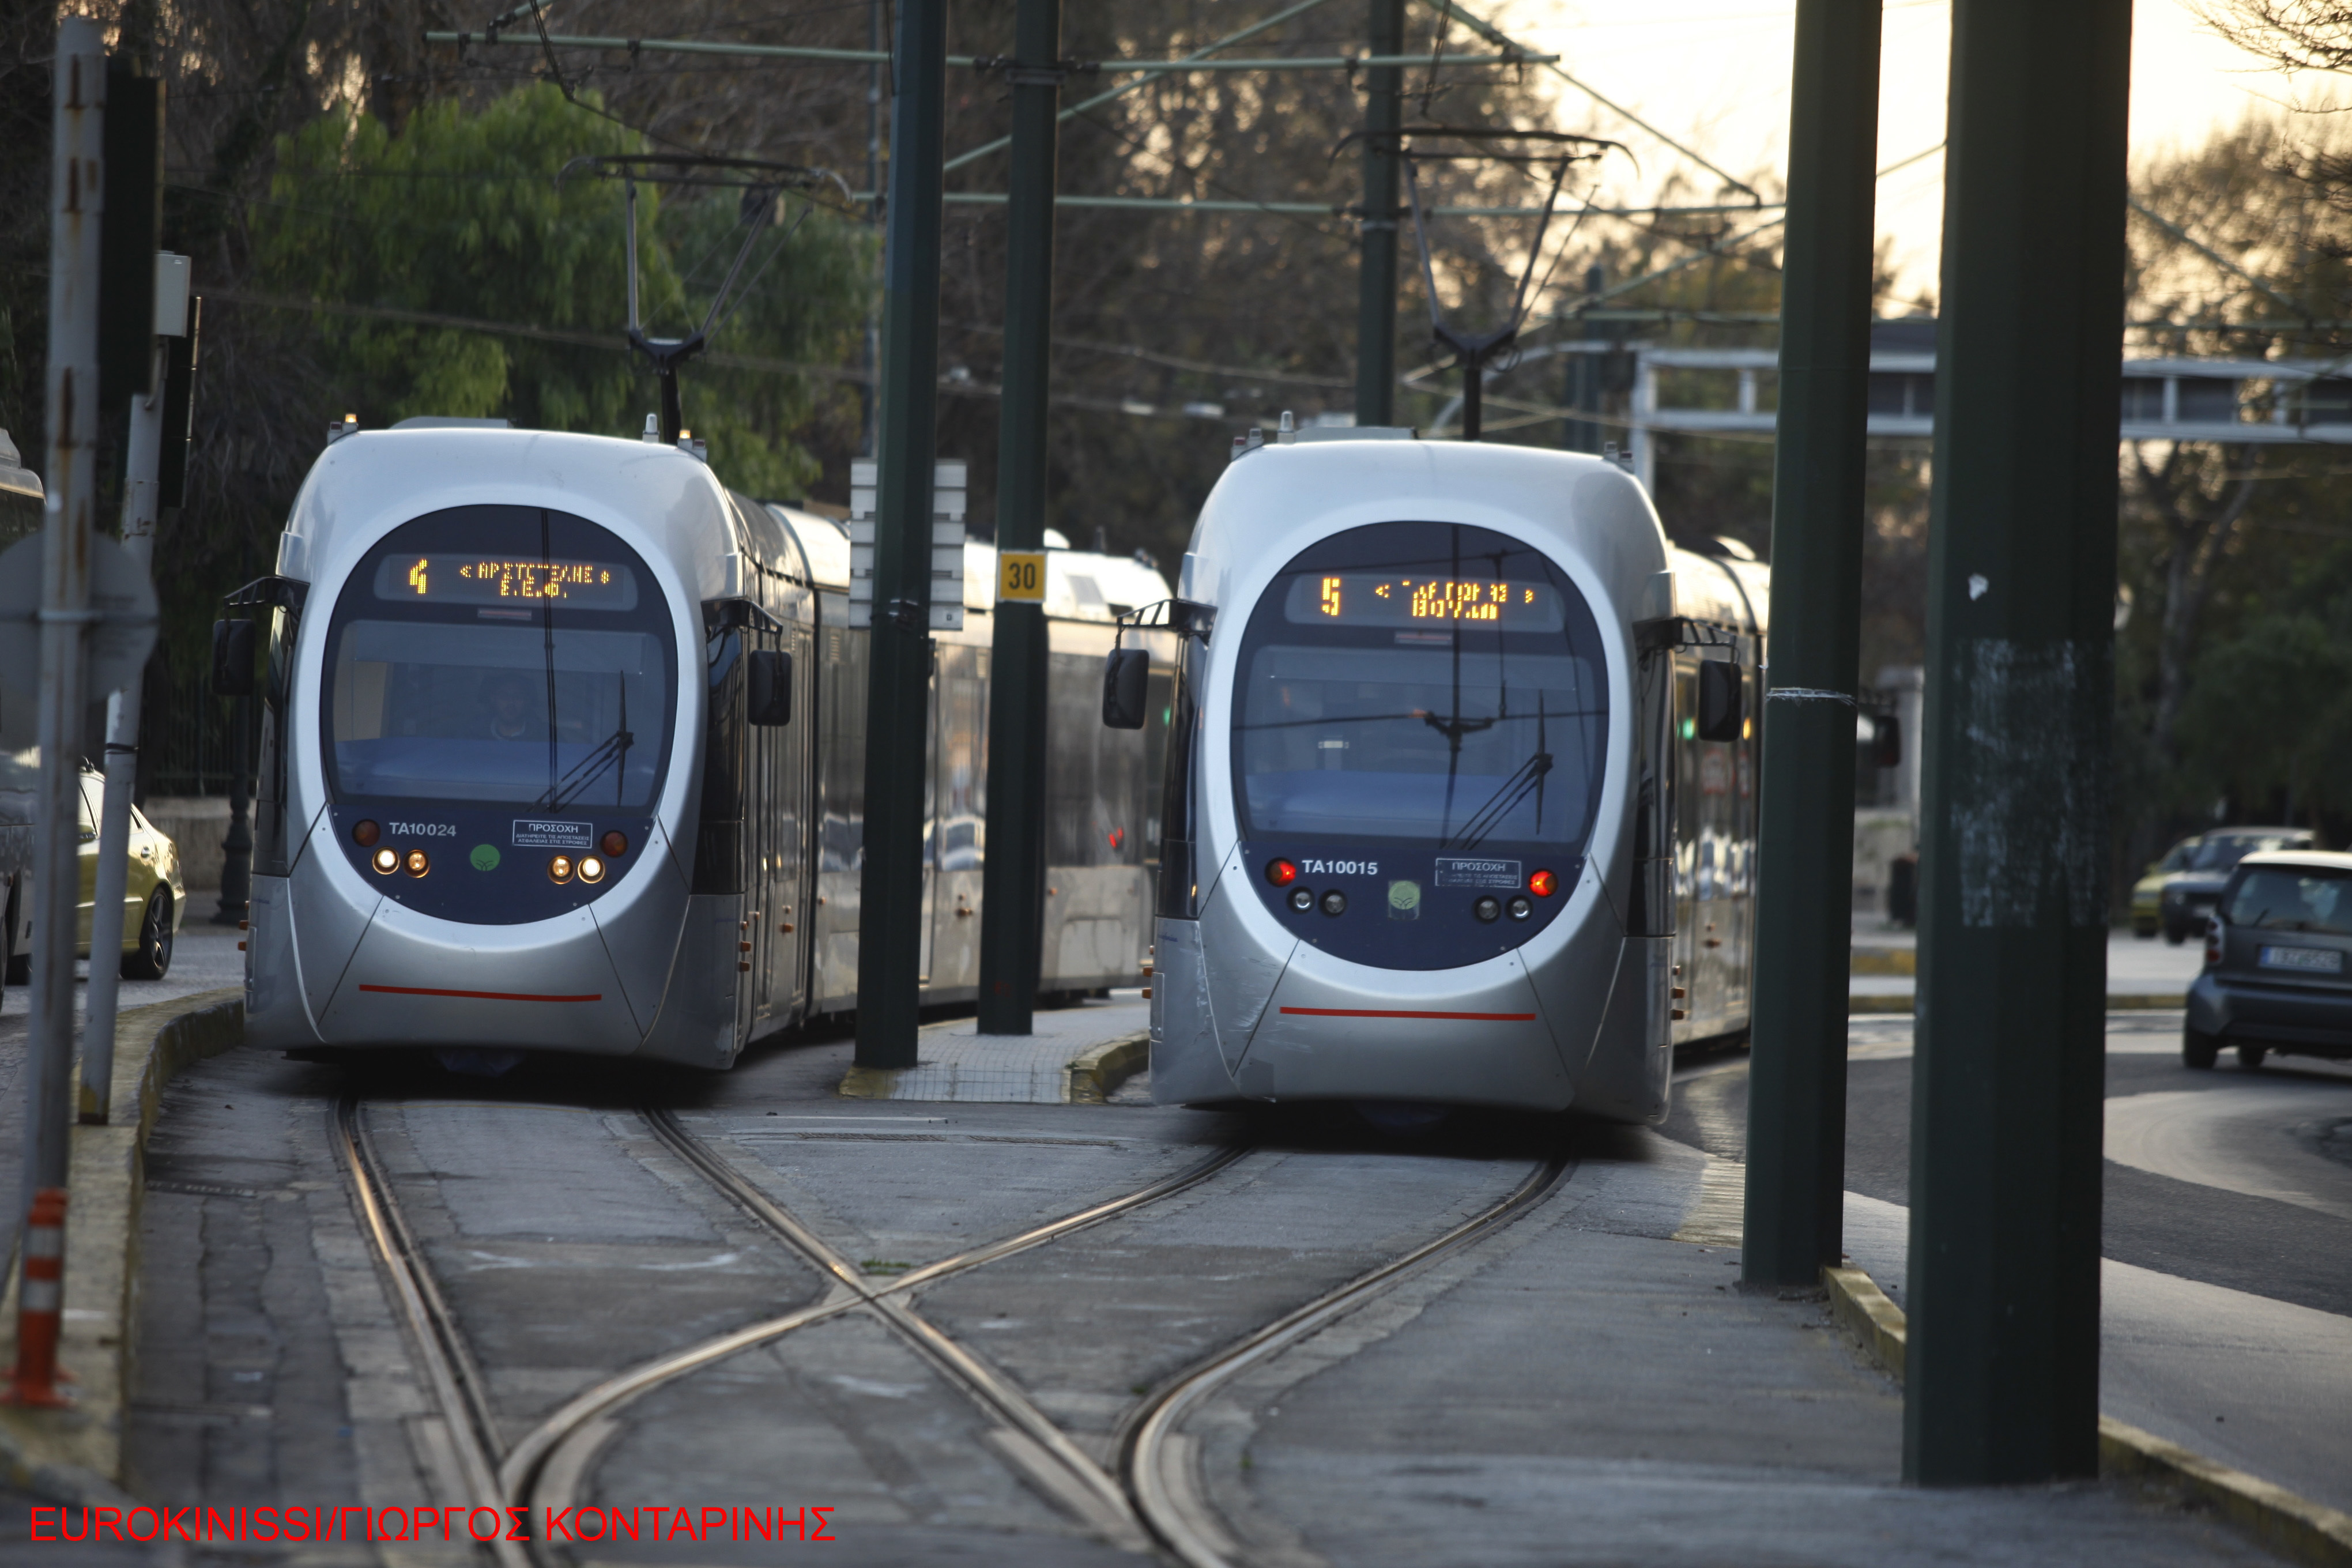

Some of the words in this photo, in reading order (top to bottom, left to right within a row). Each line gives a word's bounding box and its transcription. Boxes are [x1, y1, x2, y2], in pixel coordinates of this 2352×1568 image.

[409, 558, 427, 594] 4
[1008, 563, 1036, 590] 30
[1321, 578, 1341, 616] 5
[389, 822, 457, 836] TA10024
[529, 823, 578, 833] ΠΡΟΣΟΧΗ
[1302, 860, 1378, 875] TA10015
[1452, 861, 1506, 872] ΠΡΟΣΟΧΗ
